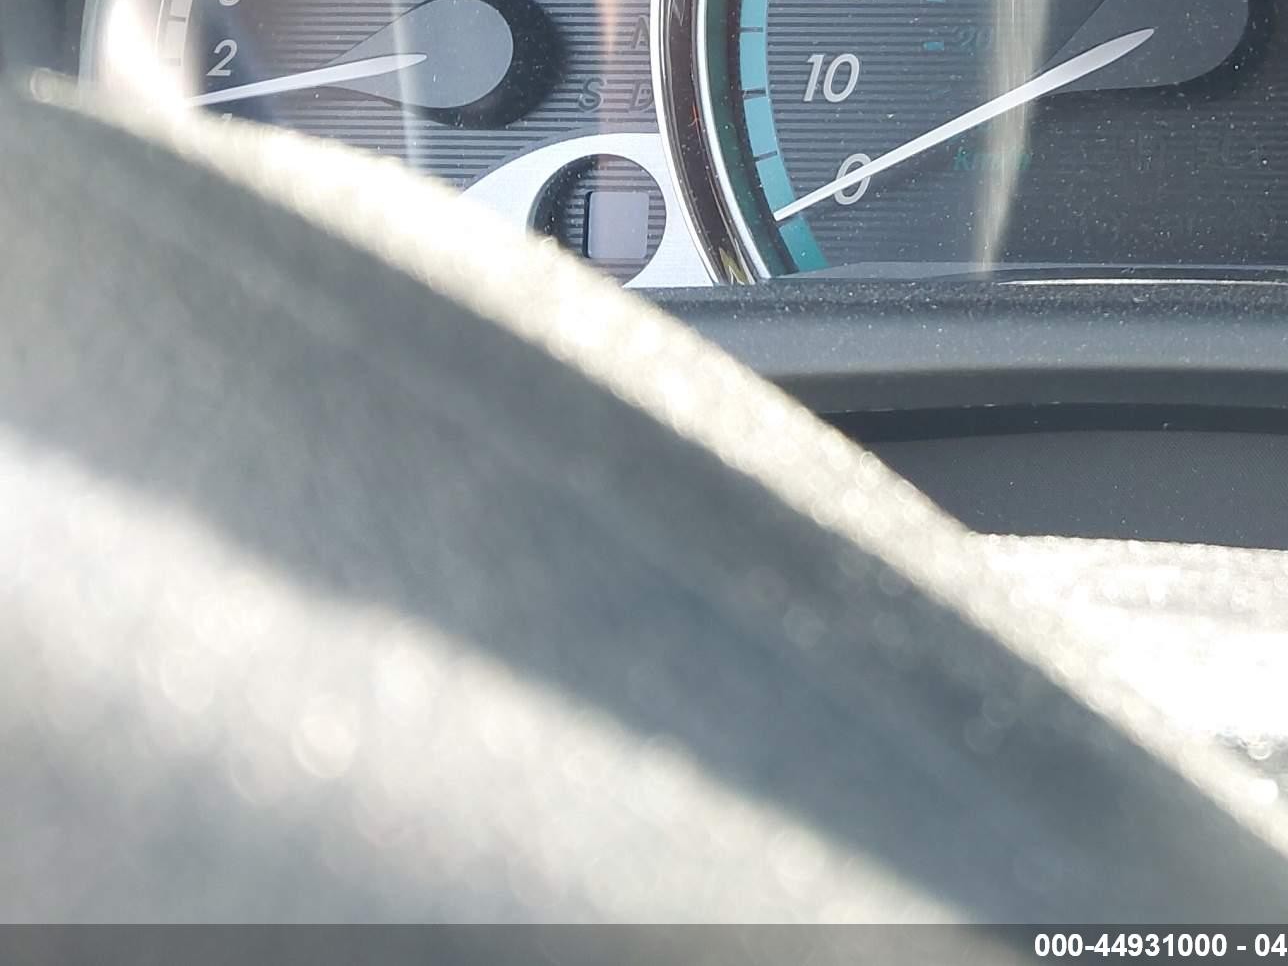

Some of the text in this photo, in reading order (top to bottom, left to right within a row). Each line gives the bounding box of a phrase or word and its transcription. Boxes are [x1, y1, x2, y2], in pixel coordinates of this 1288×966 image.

[206, 39, 237, 76] 2
[804, 54, 859, 102] 10
[834, 154, 871, 204] 0
